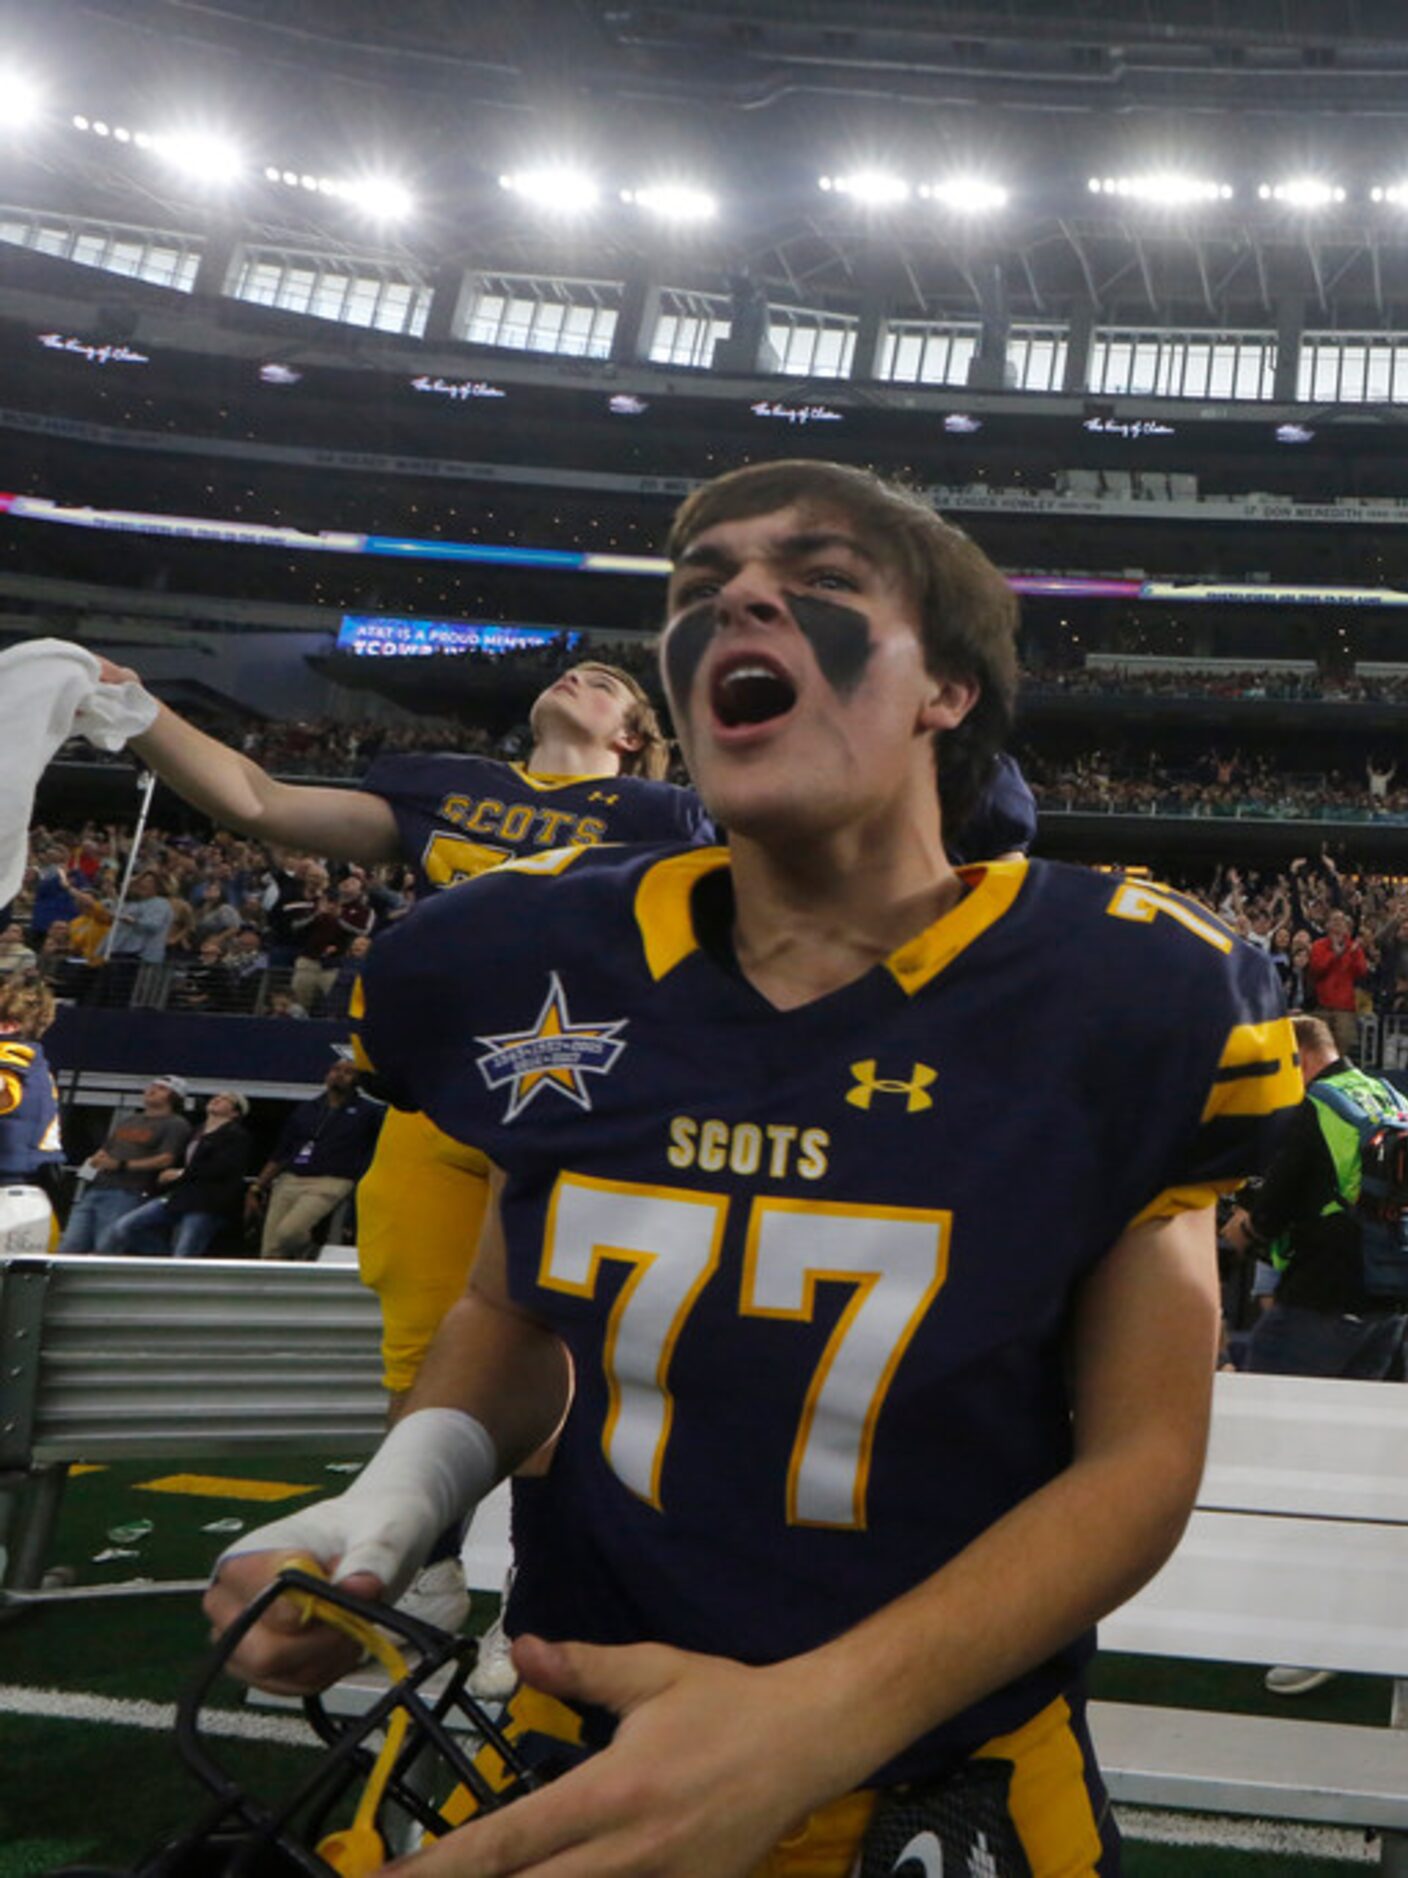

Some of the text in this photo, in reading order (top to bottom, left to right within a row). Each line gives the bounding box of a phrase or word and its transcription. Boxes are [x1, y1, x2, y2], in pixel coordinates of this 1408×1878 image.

[429, 631, 478, 645] PROUD
[437, 791, 608, 849] SCOTS
[667, 1115, 831, 1180] SCOTS
[537, 1169, 954, 1531] 77
